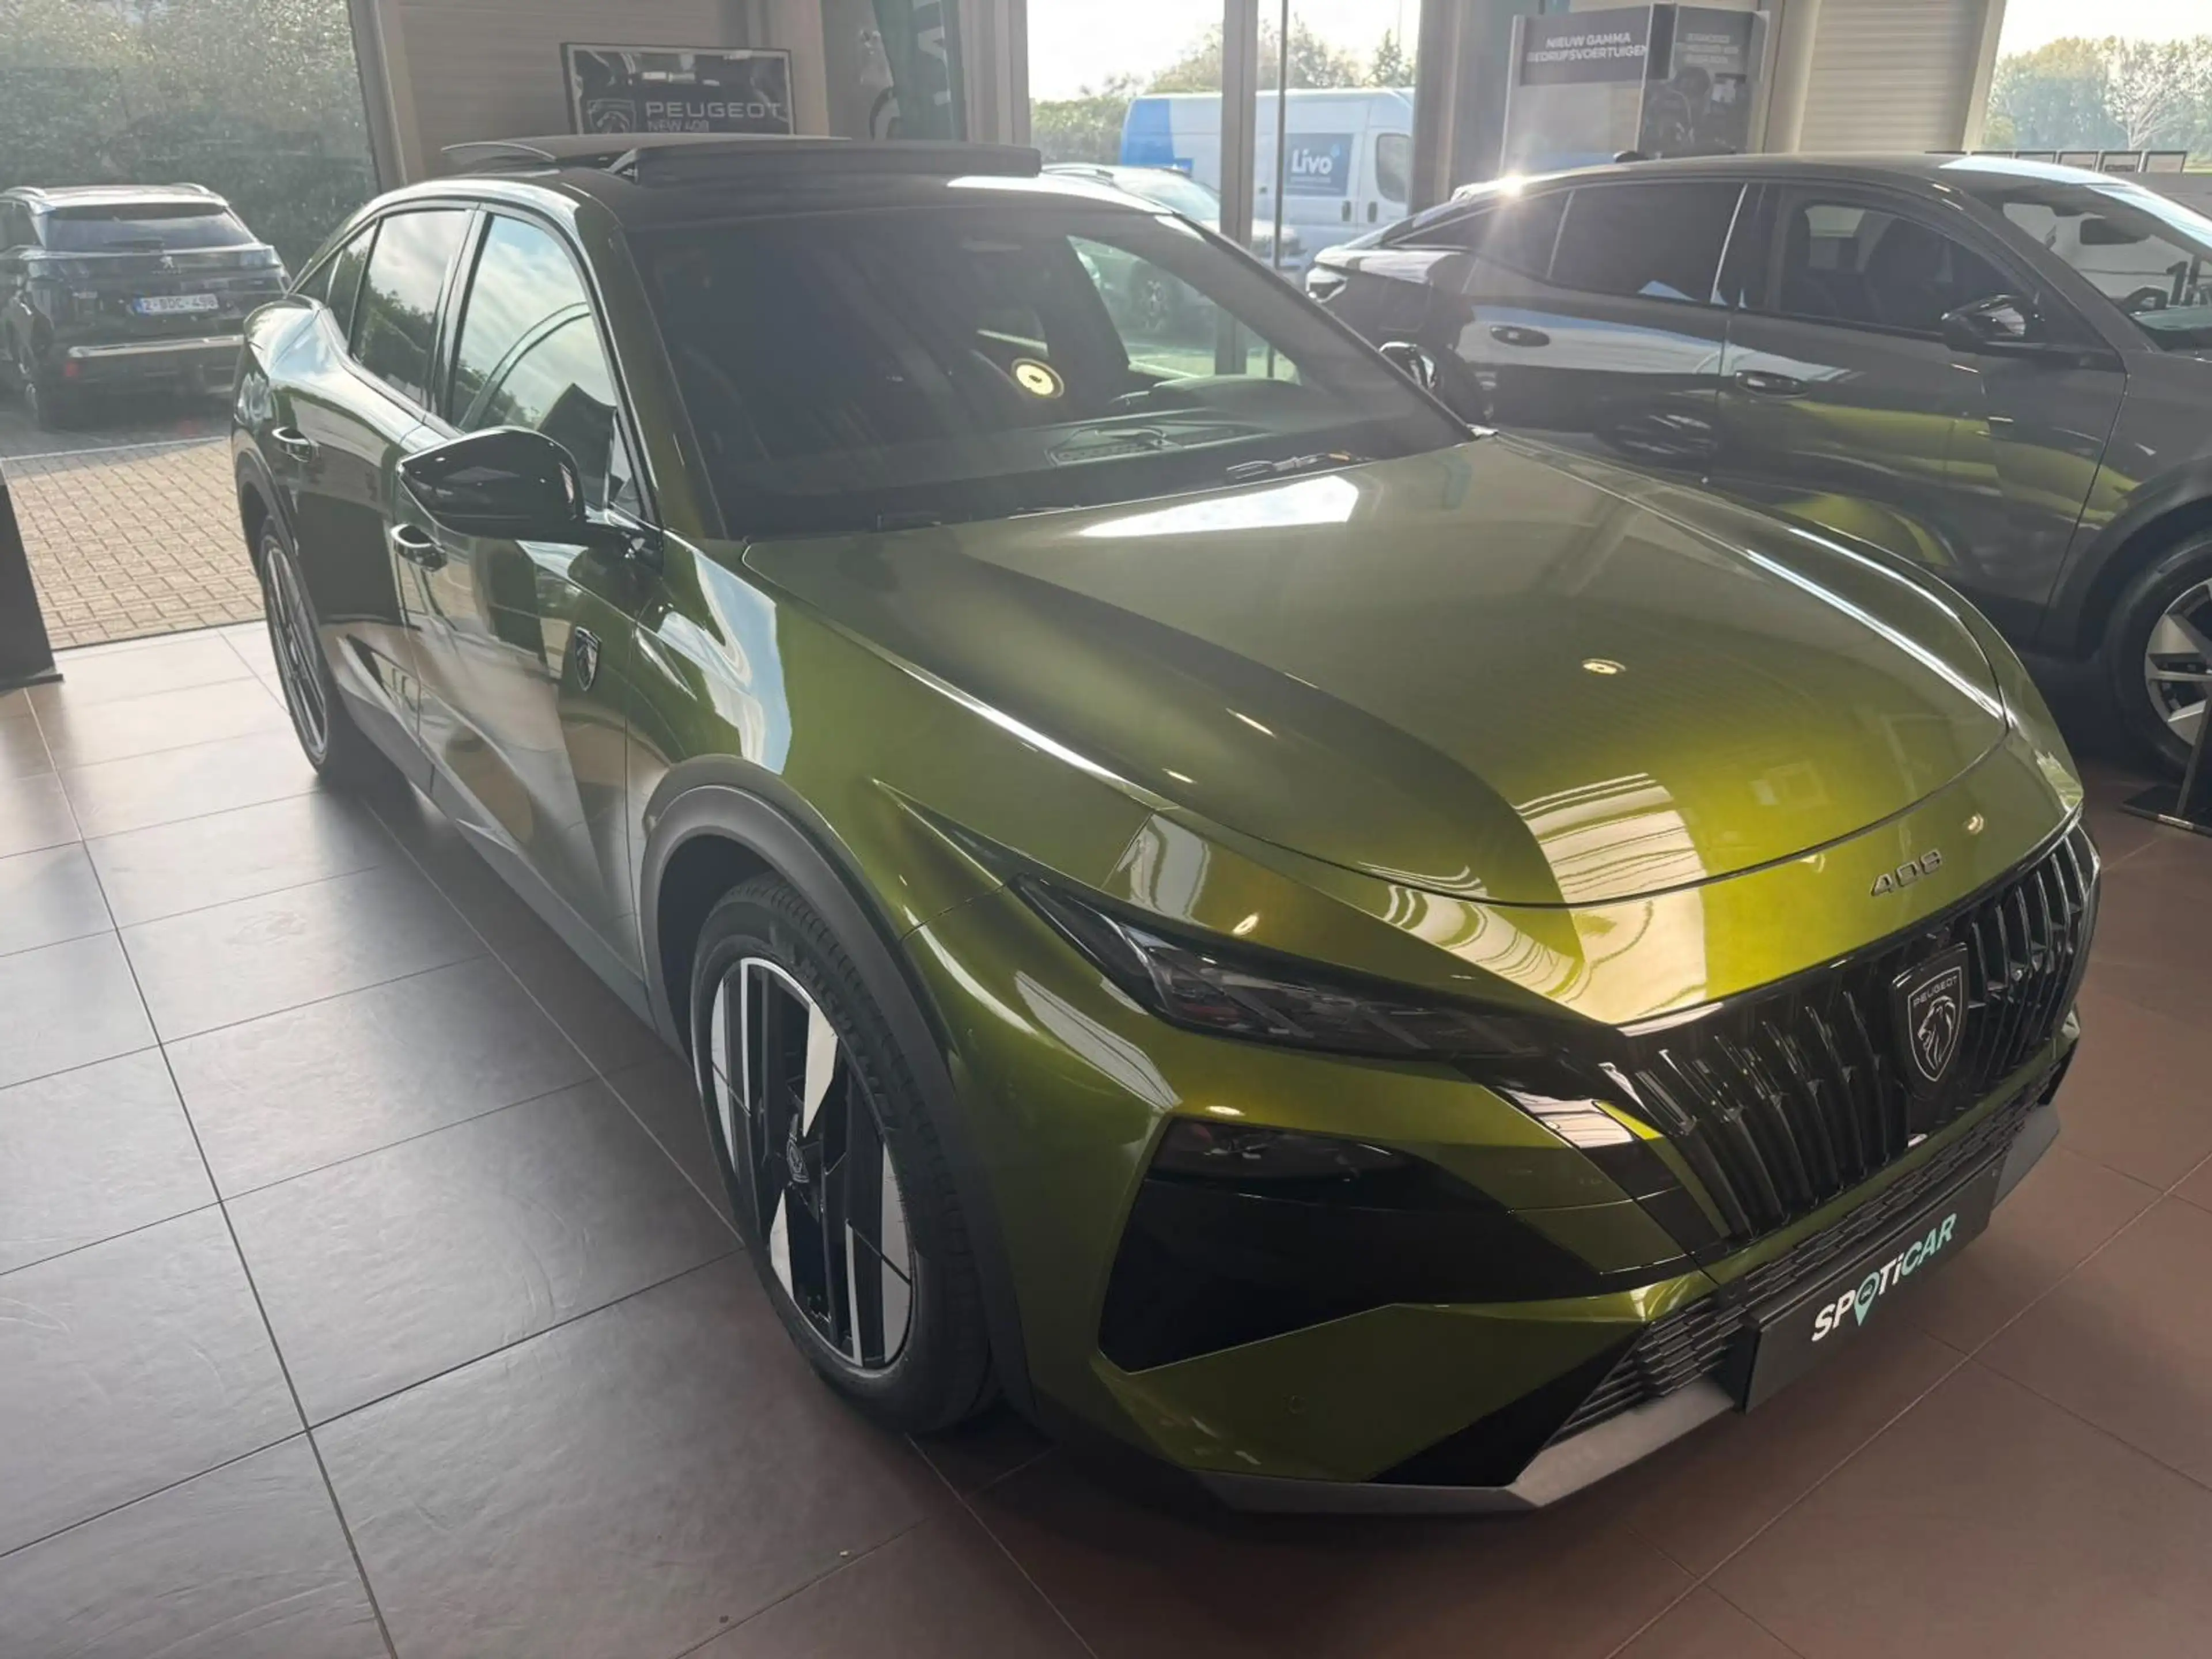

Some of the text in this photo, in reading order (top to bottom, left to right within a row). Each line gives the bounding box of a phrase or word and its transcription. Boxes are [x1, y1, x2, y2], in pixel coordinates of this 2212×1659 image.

[1546, 32, 1631, 48] NIEUW GAMMA
[646, 101, 781, 119] PEUGEOT
[1291, 148, 1332, 175] Livo
[1870, 849, 1942, 897] 408
[1912, 975, 1957, 1009] PEUGEOT
